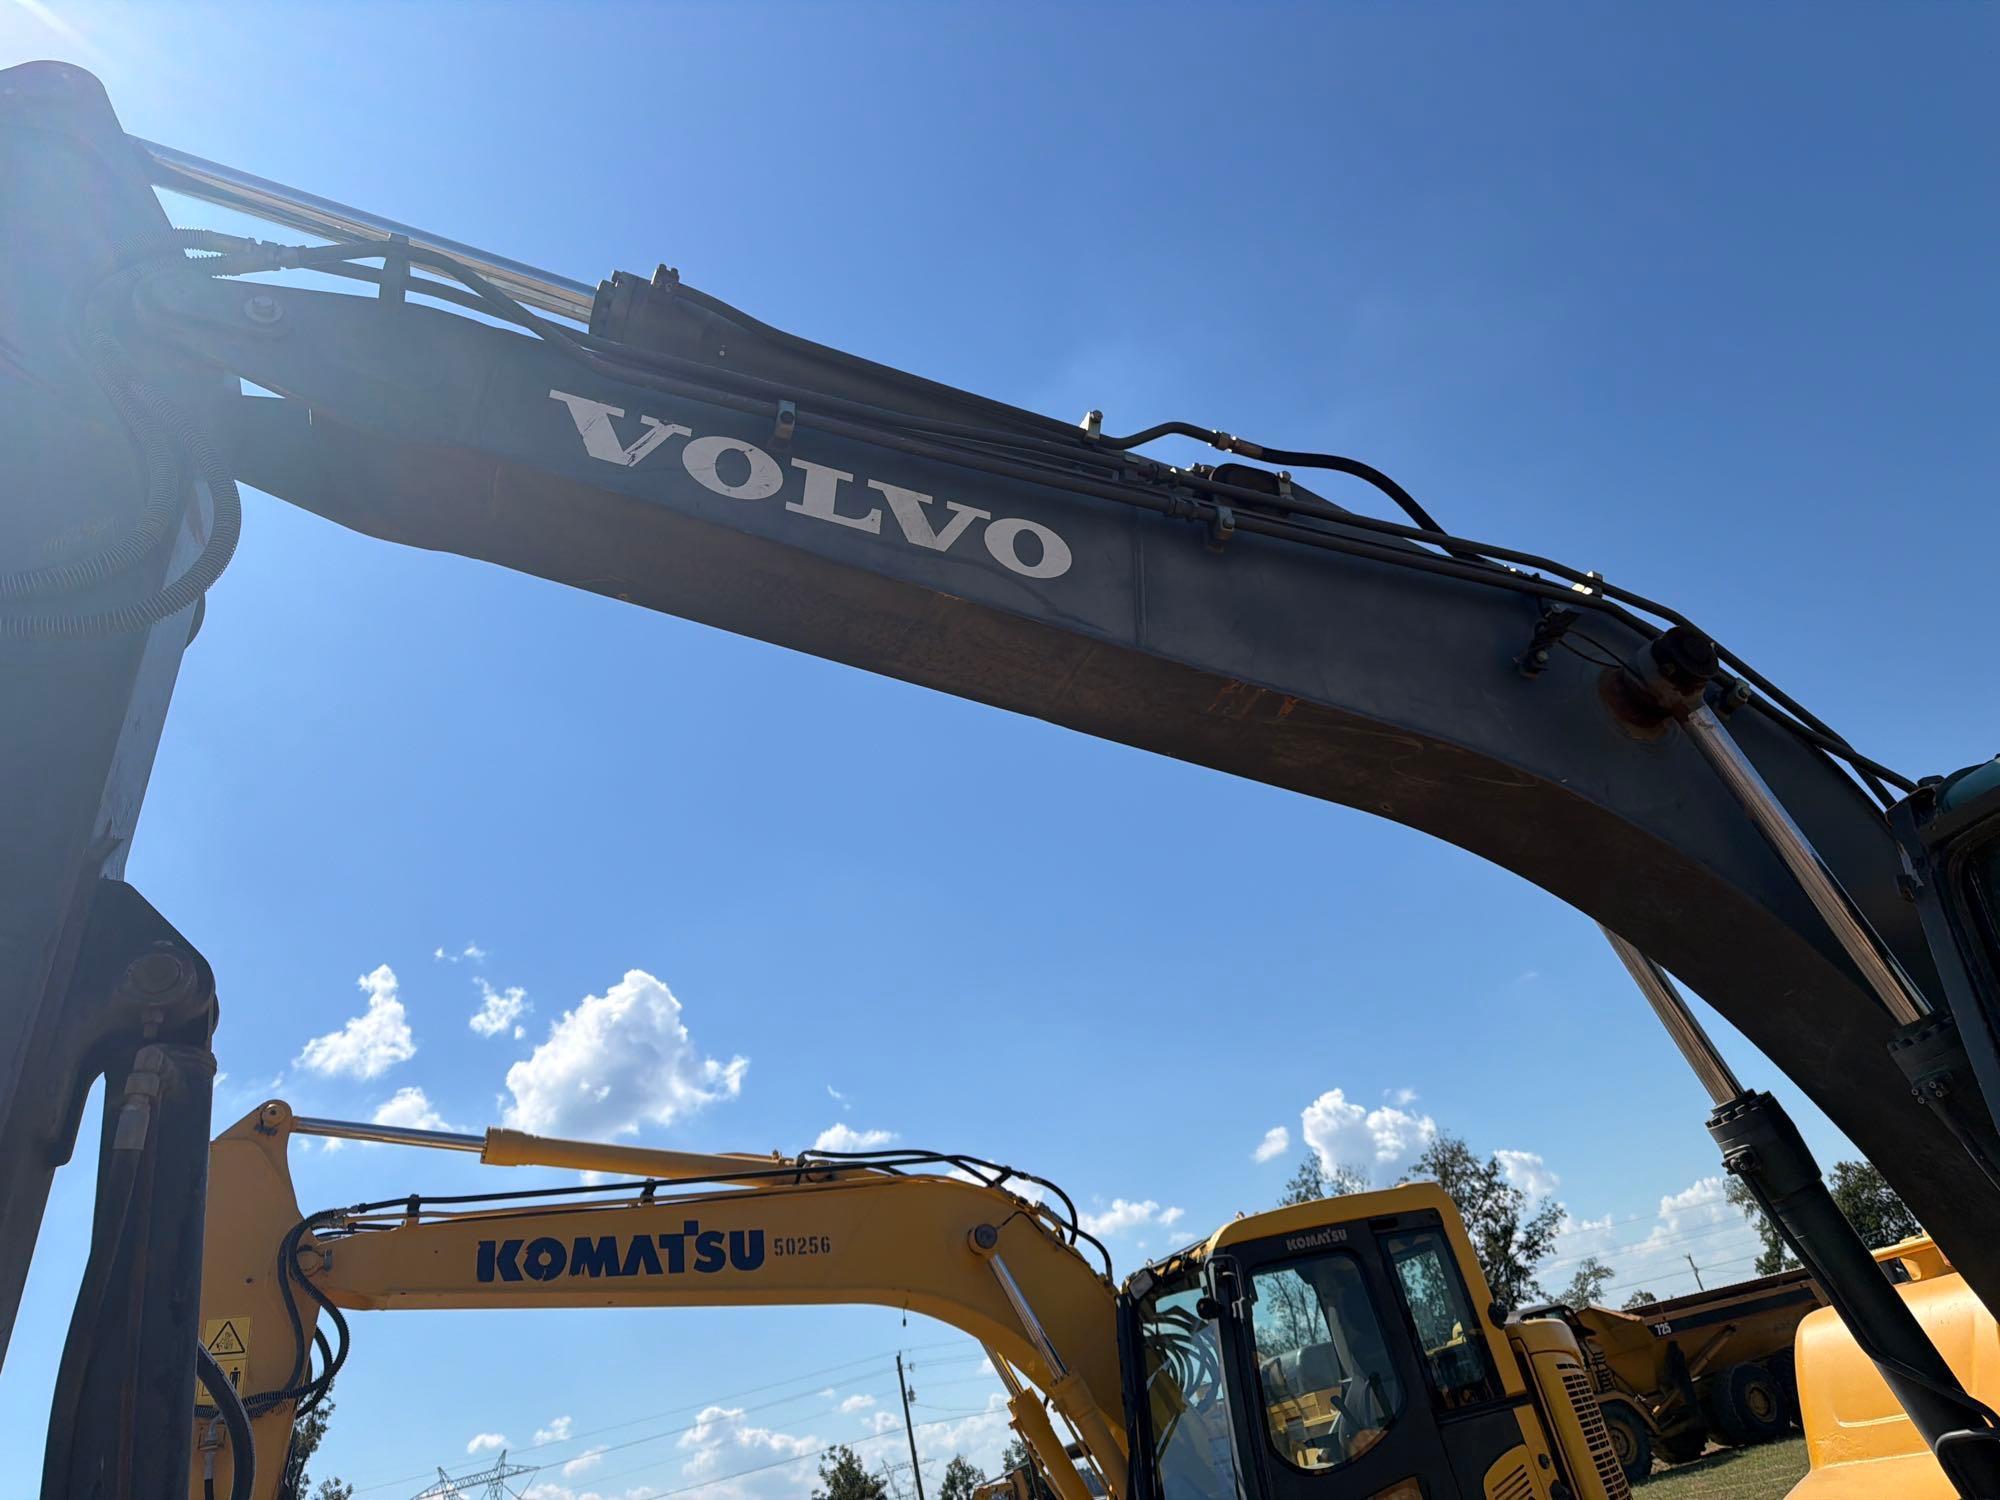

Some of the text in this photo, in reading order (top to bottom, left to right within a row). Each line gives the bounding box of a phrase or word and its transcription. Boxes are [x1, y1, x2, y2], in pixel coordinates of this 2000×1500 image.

[549, 389, 1072, 578] VOLVO
[476, 1220, 831, 1283] KOMATSU 50256
[1286, 1228, 1347, 1251] KOMATSU
[1654, 1322, 1672, 1336] 725
